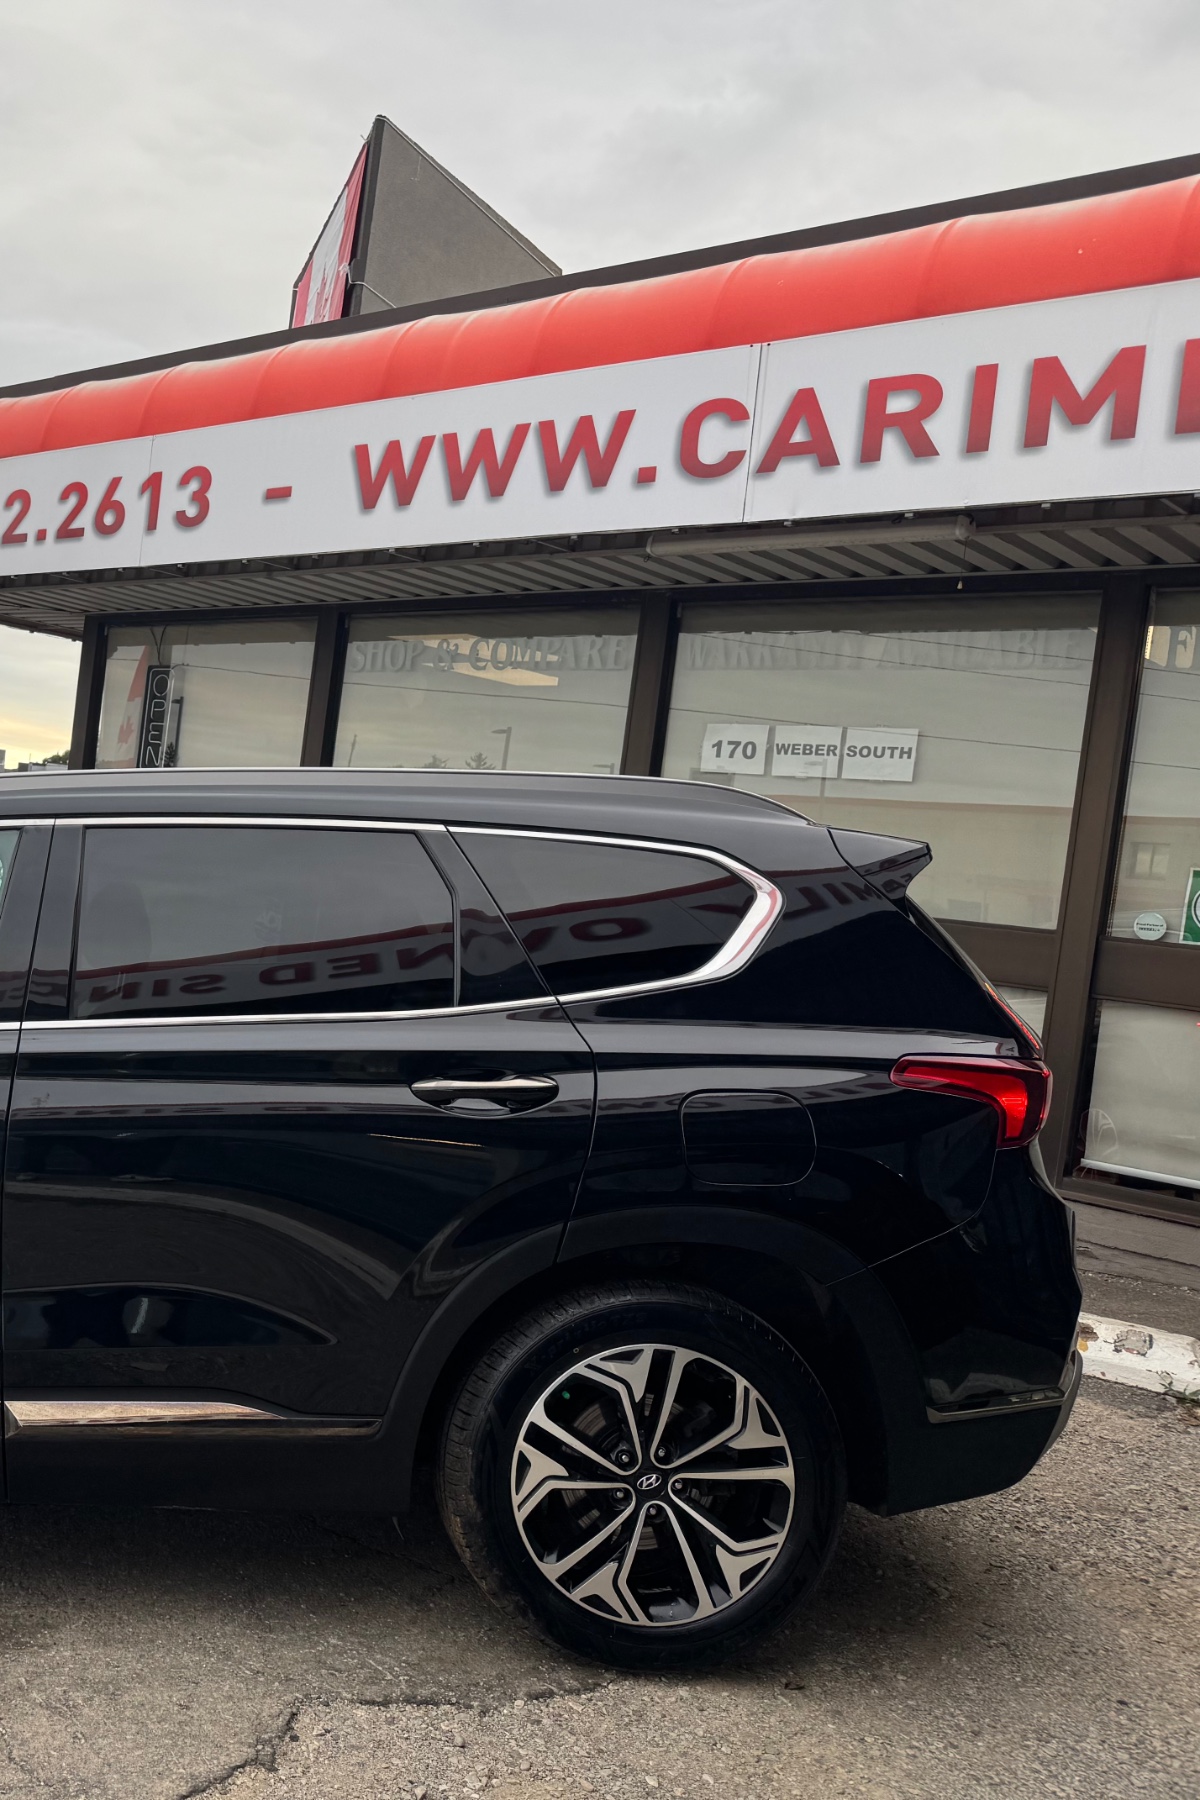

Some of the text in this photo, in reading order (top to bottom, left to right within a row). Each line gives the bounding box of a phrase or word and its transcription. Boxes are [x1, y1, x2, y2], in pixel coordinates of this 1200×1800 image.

[350, 637, 628, 673] SHOP & COMPARE
[145, 674, 171, 767] OPEN
[711, 739, 913, 760] 170 WEBER SOUTH
